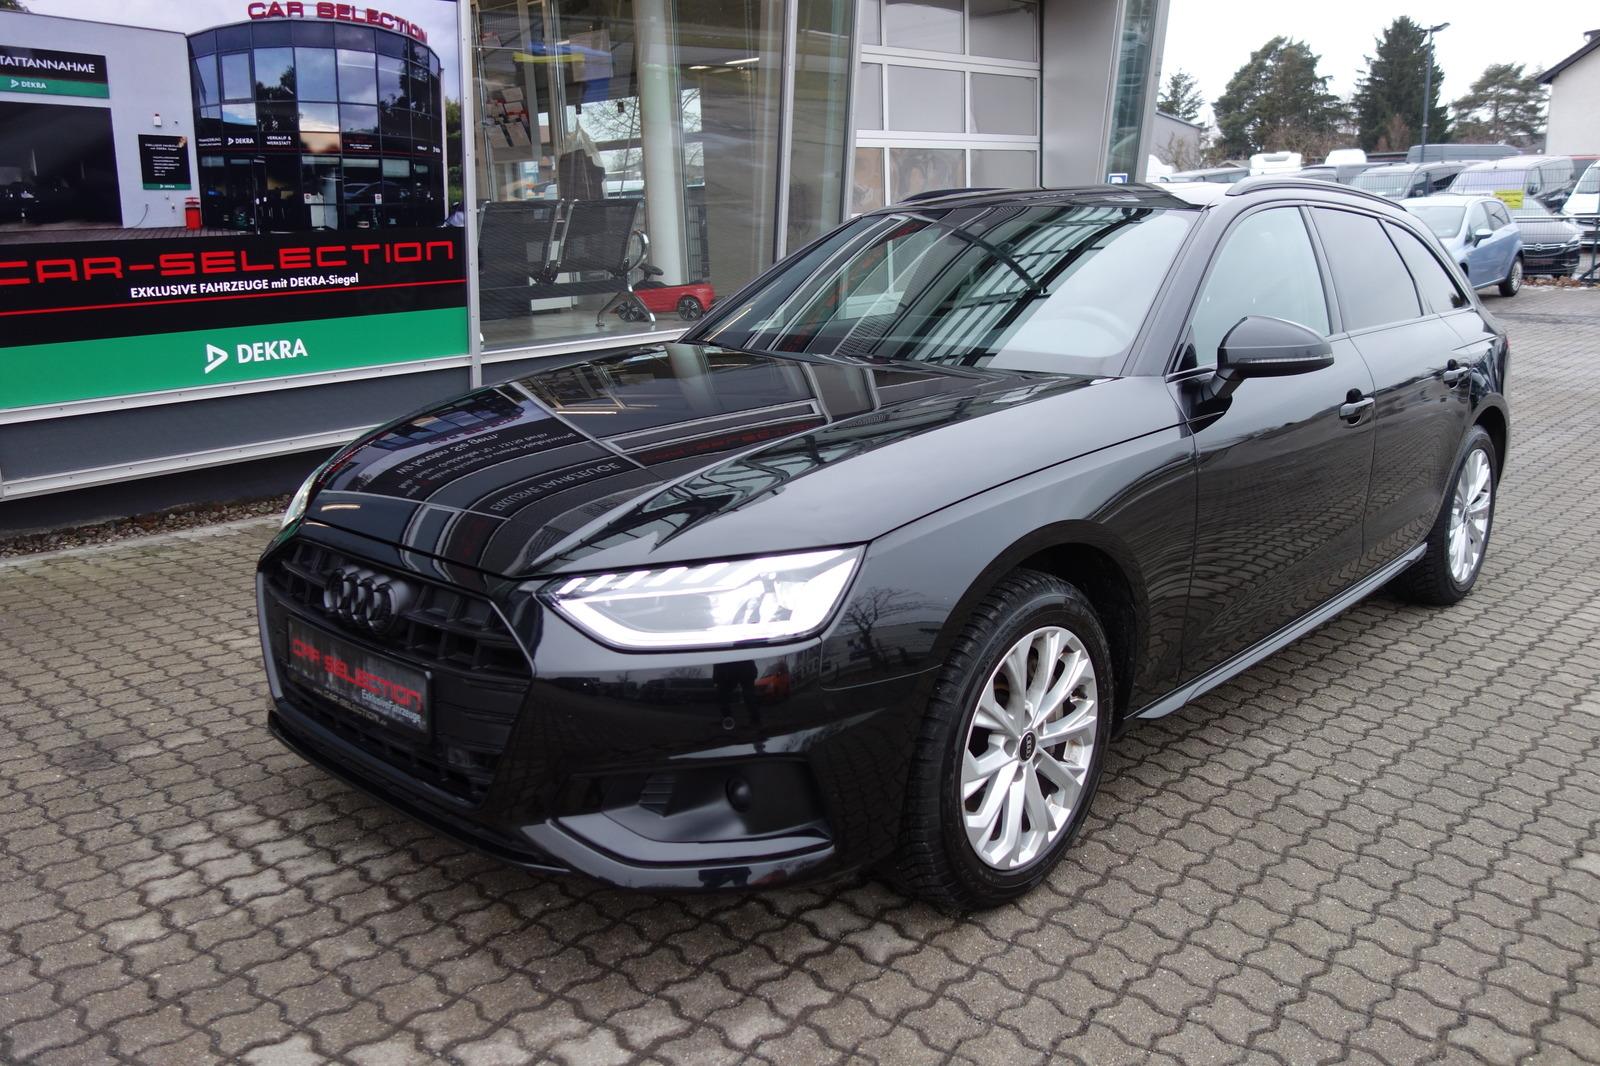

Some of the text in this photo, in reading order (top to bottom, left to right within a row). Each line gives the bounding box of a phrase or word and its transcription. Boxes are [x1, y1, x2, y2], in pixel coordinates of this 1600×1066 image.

[247, 1, 428, 44] CAR SELECTION
[21, 81, 47, 89] DEKRA
[0, 240, 455, 286] CAR-SELECTION
[130, 273, 360, 298] EXKLUSIVE FAHRZEUGE mit DEKRA-Siegel
[237, 338, 308, 365] DEKRA
